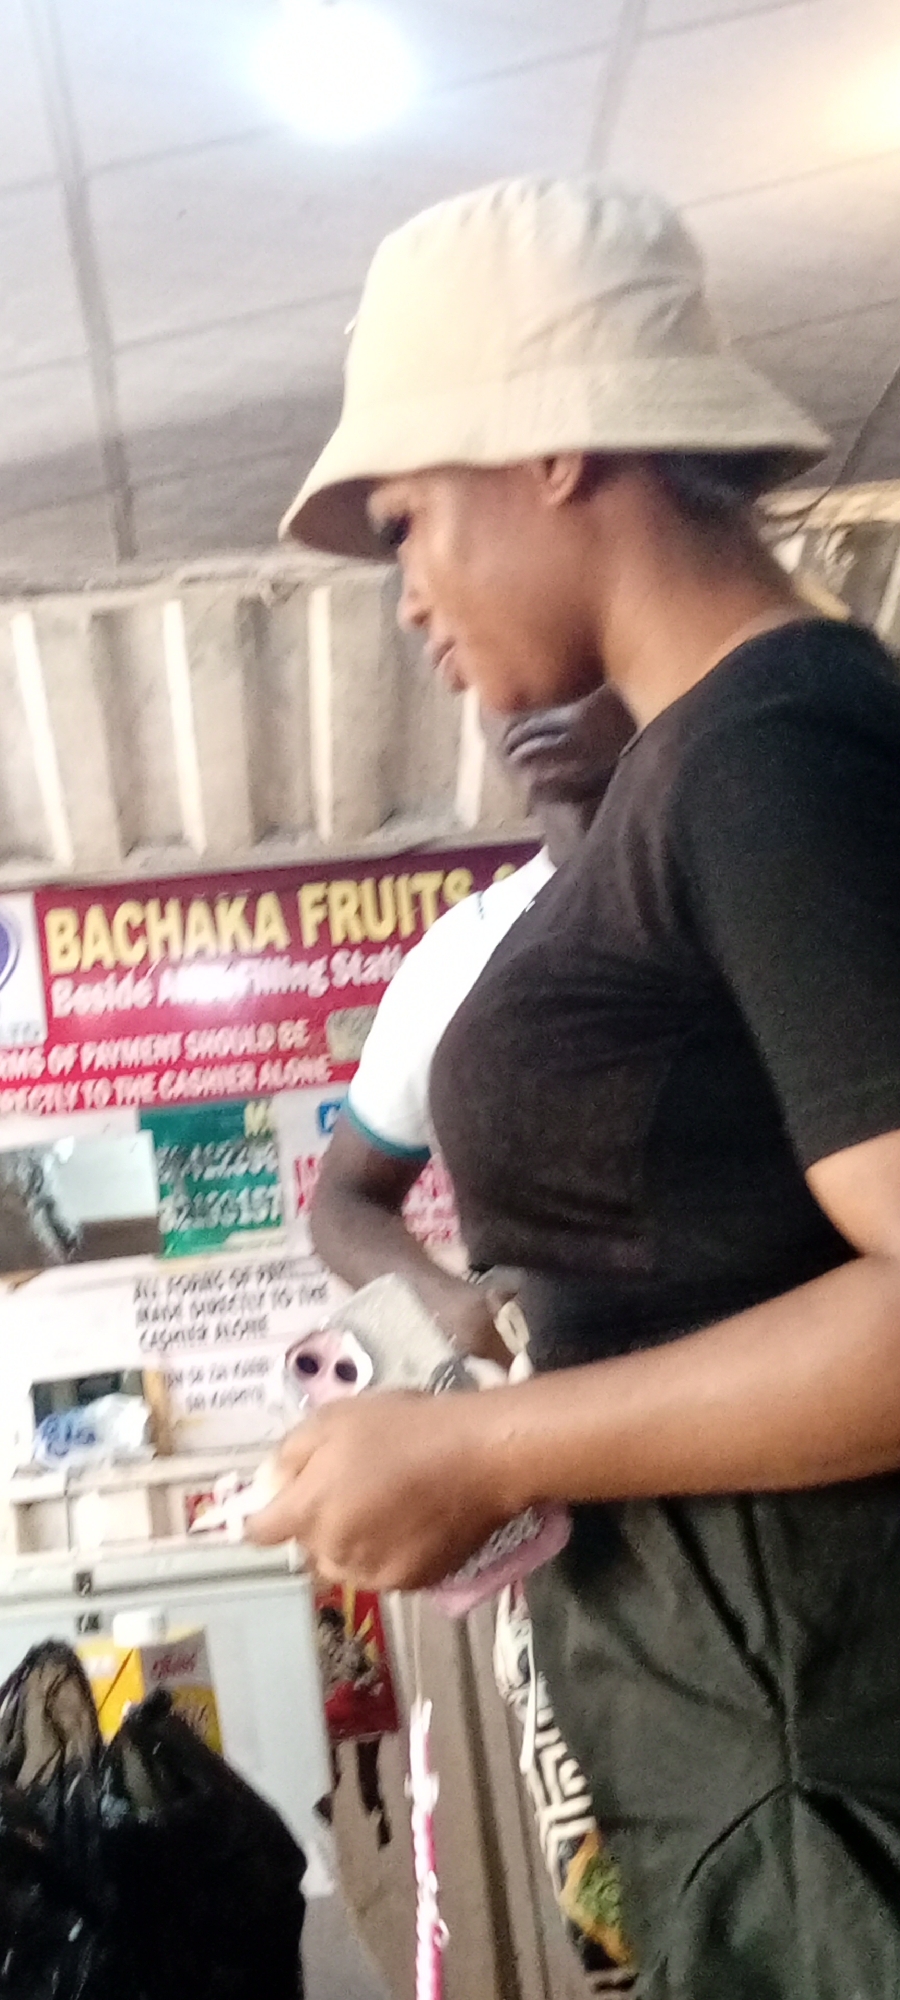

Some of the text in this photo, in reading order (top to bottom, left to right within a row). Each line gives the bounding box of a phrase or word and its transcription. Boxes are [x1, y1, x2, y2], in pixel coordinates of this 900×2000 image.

[45, 892, 290, 976] BACHAKA
[52, 969, 153, 1018] Beside
[48, 1042, 79, 1076] OF
[80, 1032, 184, 1072] PAYMENT
[184, 1023, 276, 1060] SHOULD
[277, 1019, 309, 1049] BE
[81, 1077, 113, 1109] TO
[113, 1071, 158, 1105] THE
[158, 1062, 256, 1100] CASHIER
[257, 1054, 332, 1091] ALONE
[230, 1265, 252, 1288] OF
[139, 1314, 269, 1351] CASHIER ALONE
